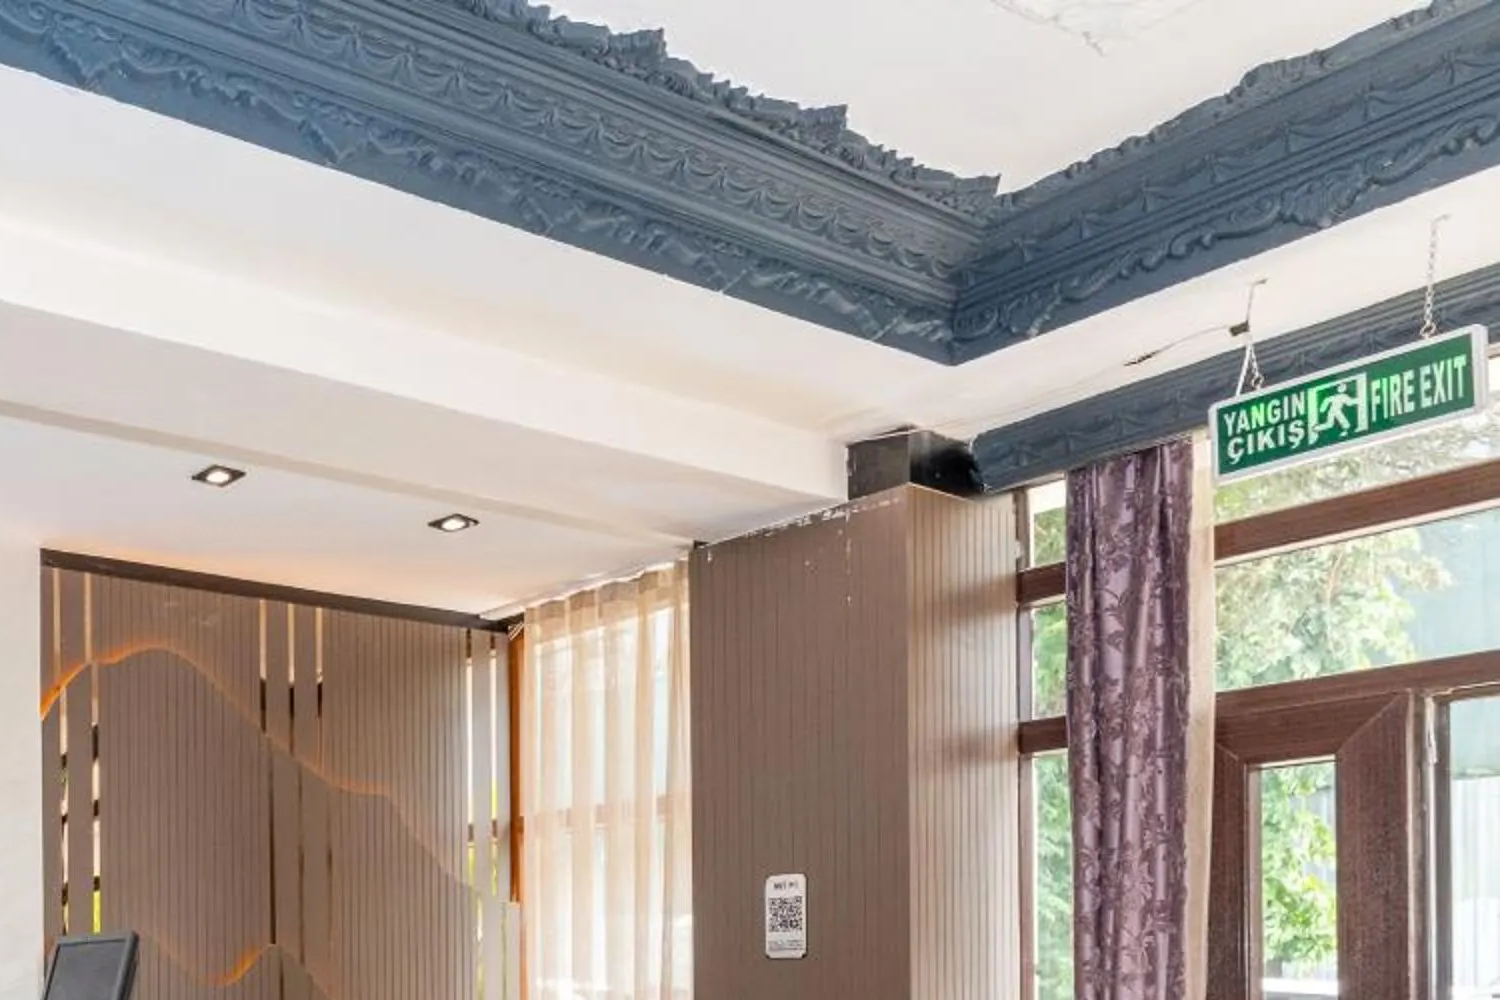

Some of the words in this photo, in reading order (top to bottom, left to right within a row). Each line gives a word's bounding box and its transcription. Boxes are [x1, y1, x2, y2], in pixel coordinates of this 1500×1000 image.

[1370, 369, 1415, 423] FIRE
[1420, 354, 1467, 407] EXIT
[1223, 390, 1305, 436] YANGIN
[1226, 417, 1305, 465] ÇIKIŞ
